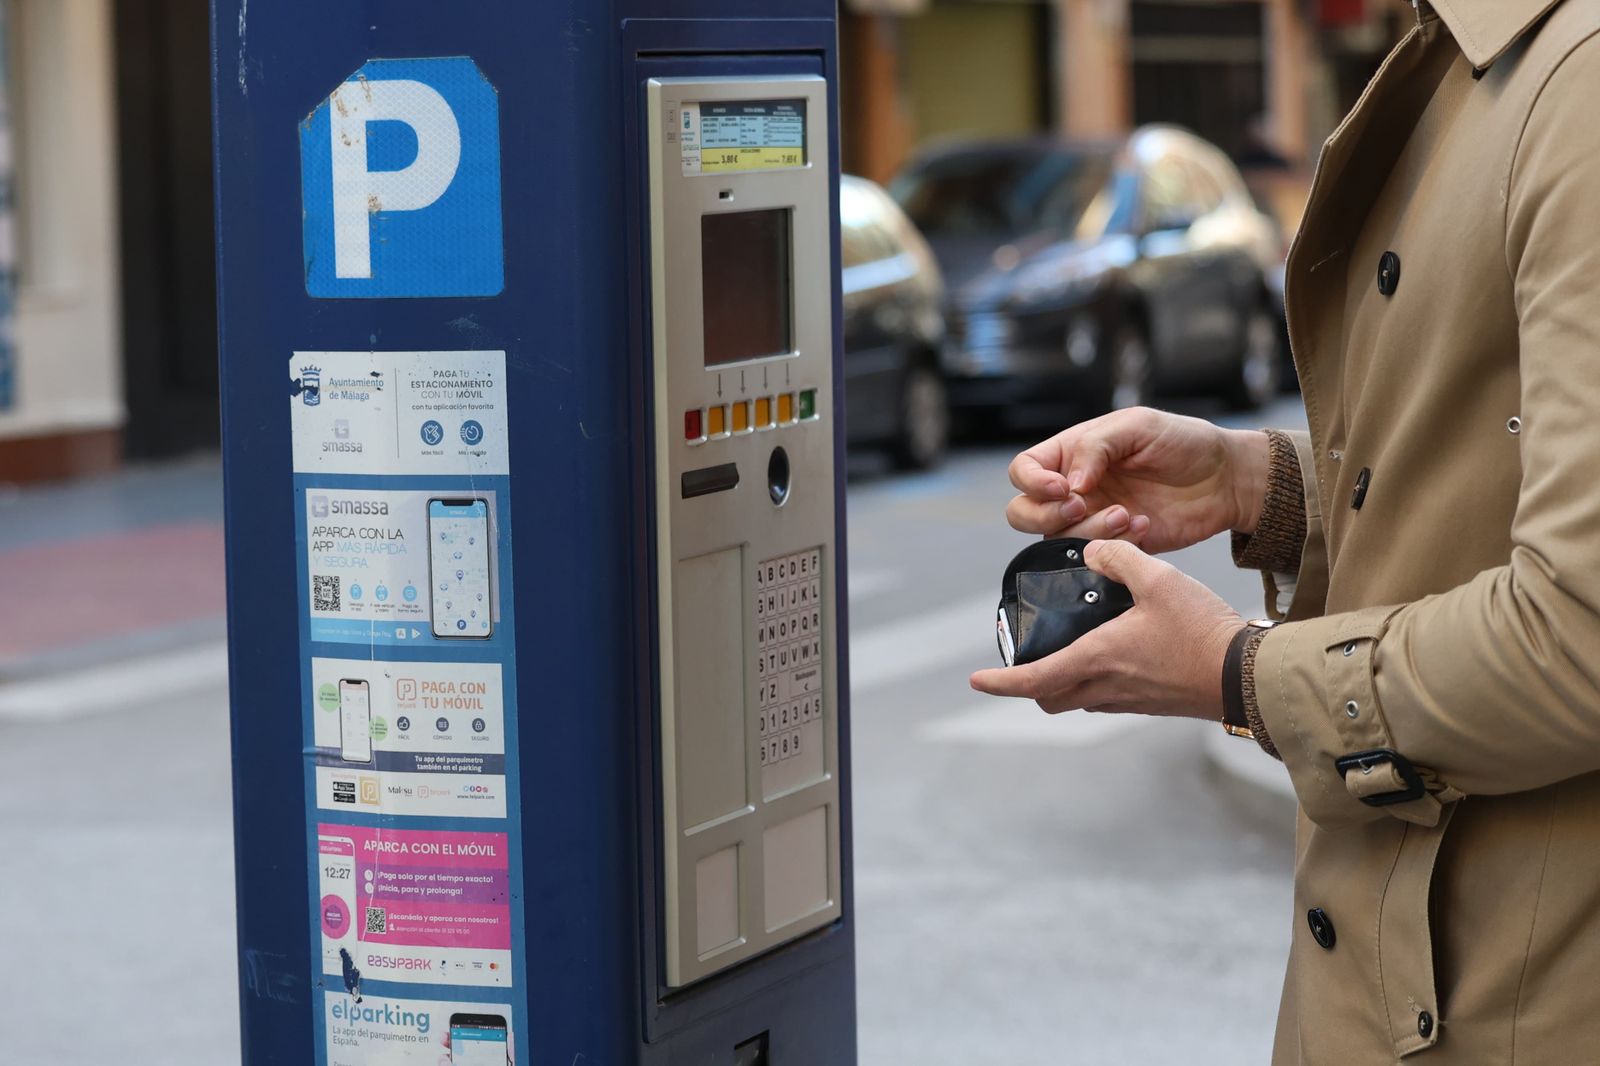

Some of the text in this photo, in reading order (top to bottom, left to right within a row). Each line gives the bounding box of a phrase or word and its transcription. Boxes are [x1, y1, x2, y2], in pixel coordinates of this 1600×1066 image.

[330, 79, 462, 279] P
[433, 370, 470, 378] PAGA TU
[329, 377, 384, 388] Ayuntamiento
[411, 380, 494, 389] ESTACIONAMIENTO
[329, 391, 370, 402] de Málaga
[421, 388, 484, 399] CON TU MÓVIL
[433, 403, 467, 412] aplicación
[322, 442, 363, 453] smassa
[331, 500, 389, 515] smassa
[312, 526, 405, 541] APARCA CON LA
[312, 541, 334, 553] APP
[313, 556, 369, 569] Y SEGURA
[768, 567, 774, 581] B
[779, 564, 785, 578] C
[790, 561, 796, 575] D
[801, 558, 807, 572] E
[812, 556, 818, 570] F
[768, 596, 774, 611] H
[791, 590, 796, 604] J
[802, 587, 807, 602] K
[812, 585, 818, 599] L
[769, 625, 775, 640] N
[780, 622, 786, 637] O
[792, 619, 797, 634] P
[802, 616, 808, 630] Q
[813, 613, 819, 627] R
[769, 655, 775, 669] T
[780, 651, 787, 666] U
[792, 648, 798, 662] V
[802, 645, 809, 659] W
[813, 641, 819, 656] X
[421, 681, 486, 695] PAGA CON
[770, 684, 776, 699] Z
[421, 694, 484, 710] TU MÓVIL
[771, 713, 776, 727] 1
[782, 709, 788, 724] 2
[793, 706, 798, 720] 3
[804, 703, 809, 716] 4
[815, 699, 820, 713] 5
[771, 743, 776, 758] 7
[782, 739, 788, 753] 8
[793, 735, 799, 750] 9
[459, 764, 482, 773] parking
[364, 840, 497, 857] APARCA CON EL MÓVIL
[324, 867, 351, 880] 12:27
[398, 873, 413, 881] solo
[414, 874, 428, 883] por
[429, 874, 436, 882] el
[437, 874, 464, 885] tiempo
[465, 876, 494, 886] exacto!
[401, 886, 419, 896] para
[420, 888, 426, 896] y
[426, 887, 463, 899] prolonga!
[429, 917, 454, 925] aparca
[468, 918, 499, 926] nosotros!
[332, 999, 431, 1034] elparking
[333, 1026, 341, 1035] La
[342, 1028, 356, 1038] app
[357, 1028, 369, 1038] del
[418, 1036, 429, 1044] en
[333, 1036, 360, 1048] España.
